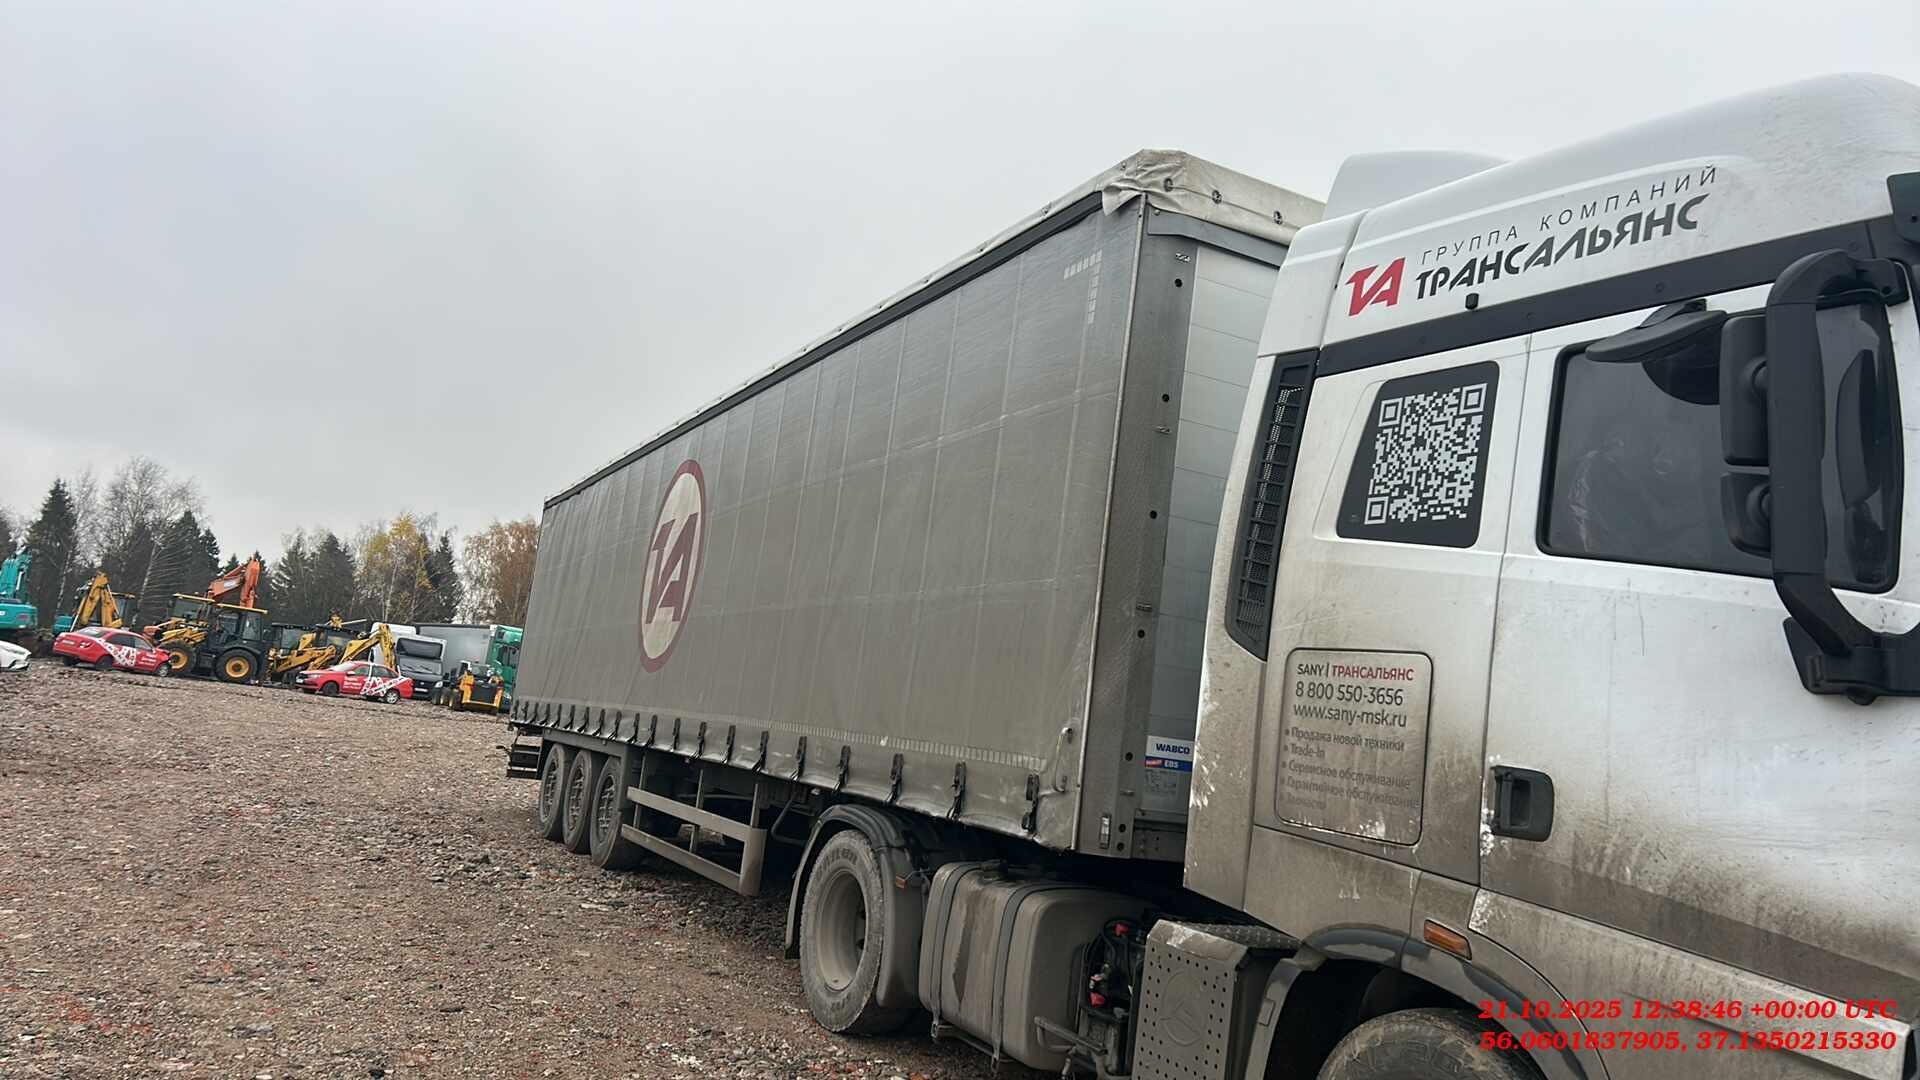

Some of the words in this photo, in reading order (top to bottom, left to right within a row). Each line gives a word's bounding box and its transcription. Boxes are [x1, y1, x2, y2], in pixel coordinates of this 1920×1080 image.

[1421, 226, 1518, 265] ГРУППА
[1540, 165, 1717, 231] КОМПАНИЙ
[1415, 193, 1710, 300] ТРАНСАЛЬЯНС
[1297, 663, 1325, 676] SANY
[1332, 665, 1415, 681] ТРАНСАЛЬЯНС
[1295, 681, 1304, 698] 8
[1307, 682, 1334, 700] 800
[1336, 684, 1404, 706] 550-3656
[1293, 703, 1407, 728] www.sany-msk.ru
[1155, 743, 1191, 755] WABCO
